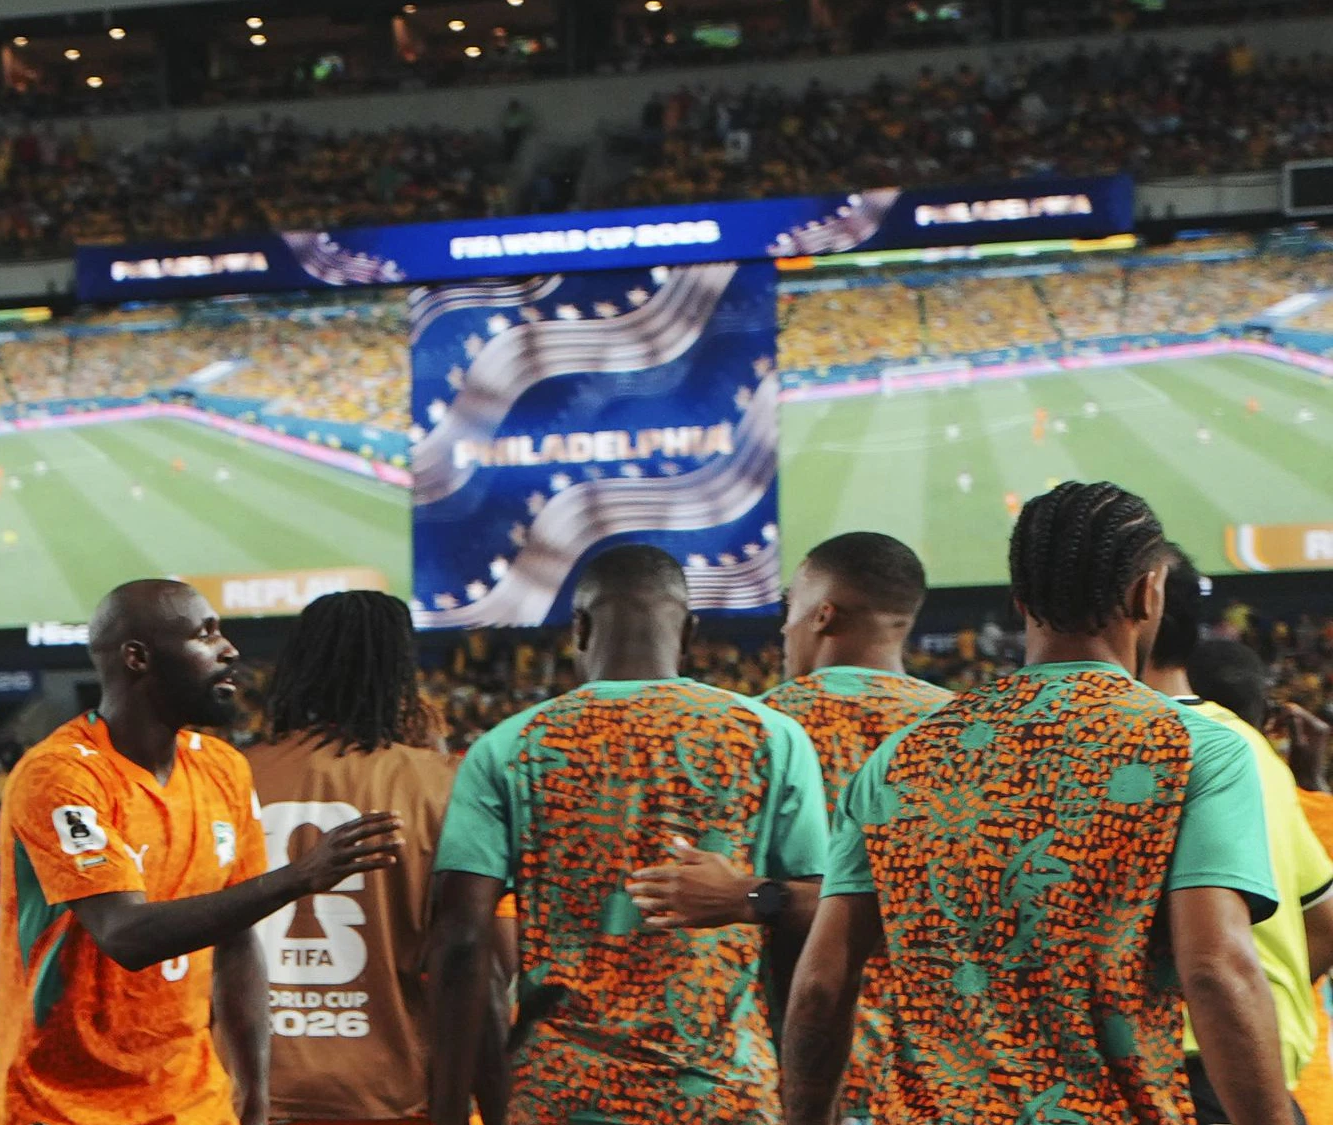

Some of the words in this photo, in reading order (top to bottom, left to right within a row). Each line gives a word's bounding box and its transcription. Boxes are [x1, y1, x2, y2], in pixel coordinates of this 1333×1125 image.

[502, 229, 586, 255] WORLD
[587, 226, 634, 251] CUP
[453, 421, 734, 469] PHILADELPHIA
[281, 949, 334, 967] FIFA
[268, 990, 323, 1008] ORLD
[323, 990, 369, 1008] CUP
[269, 1009, 370, 1037] 026
